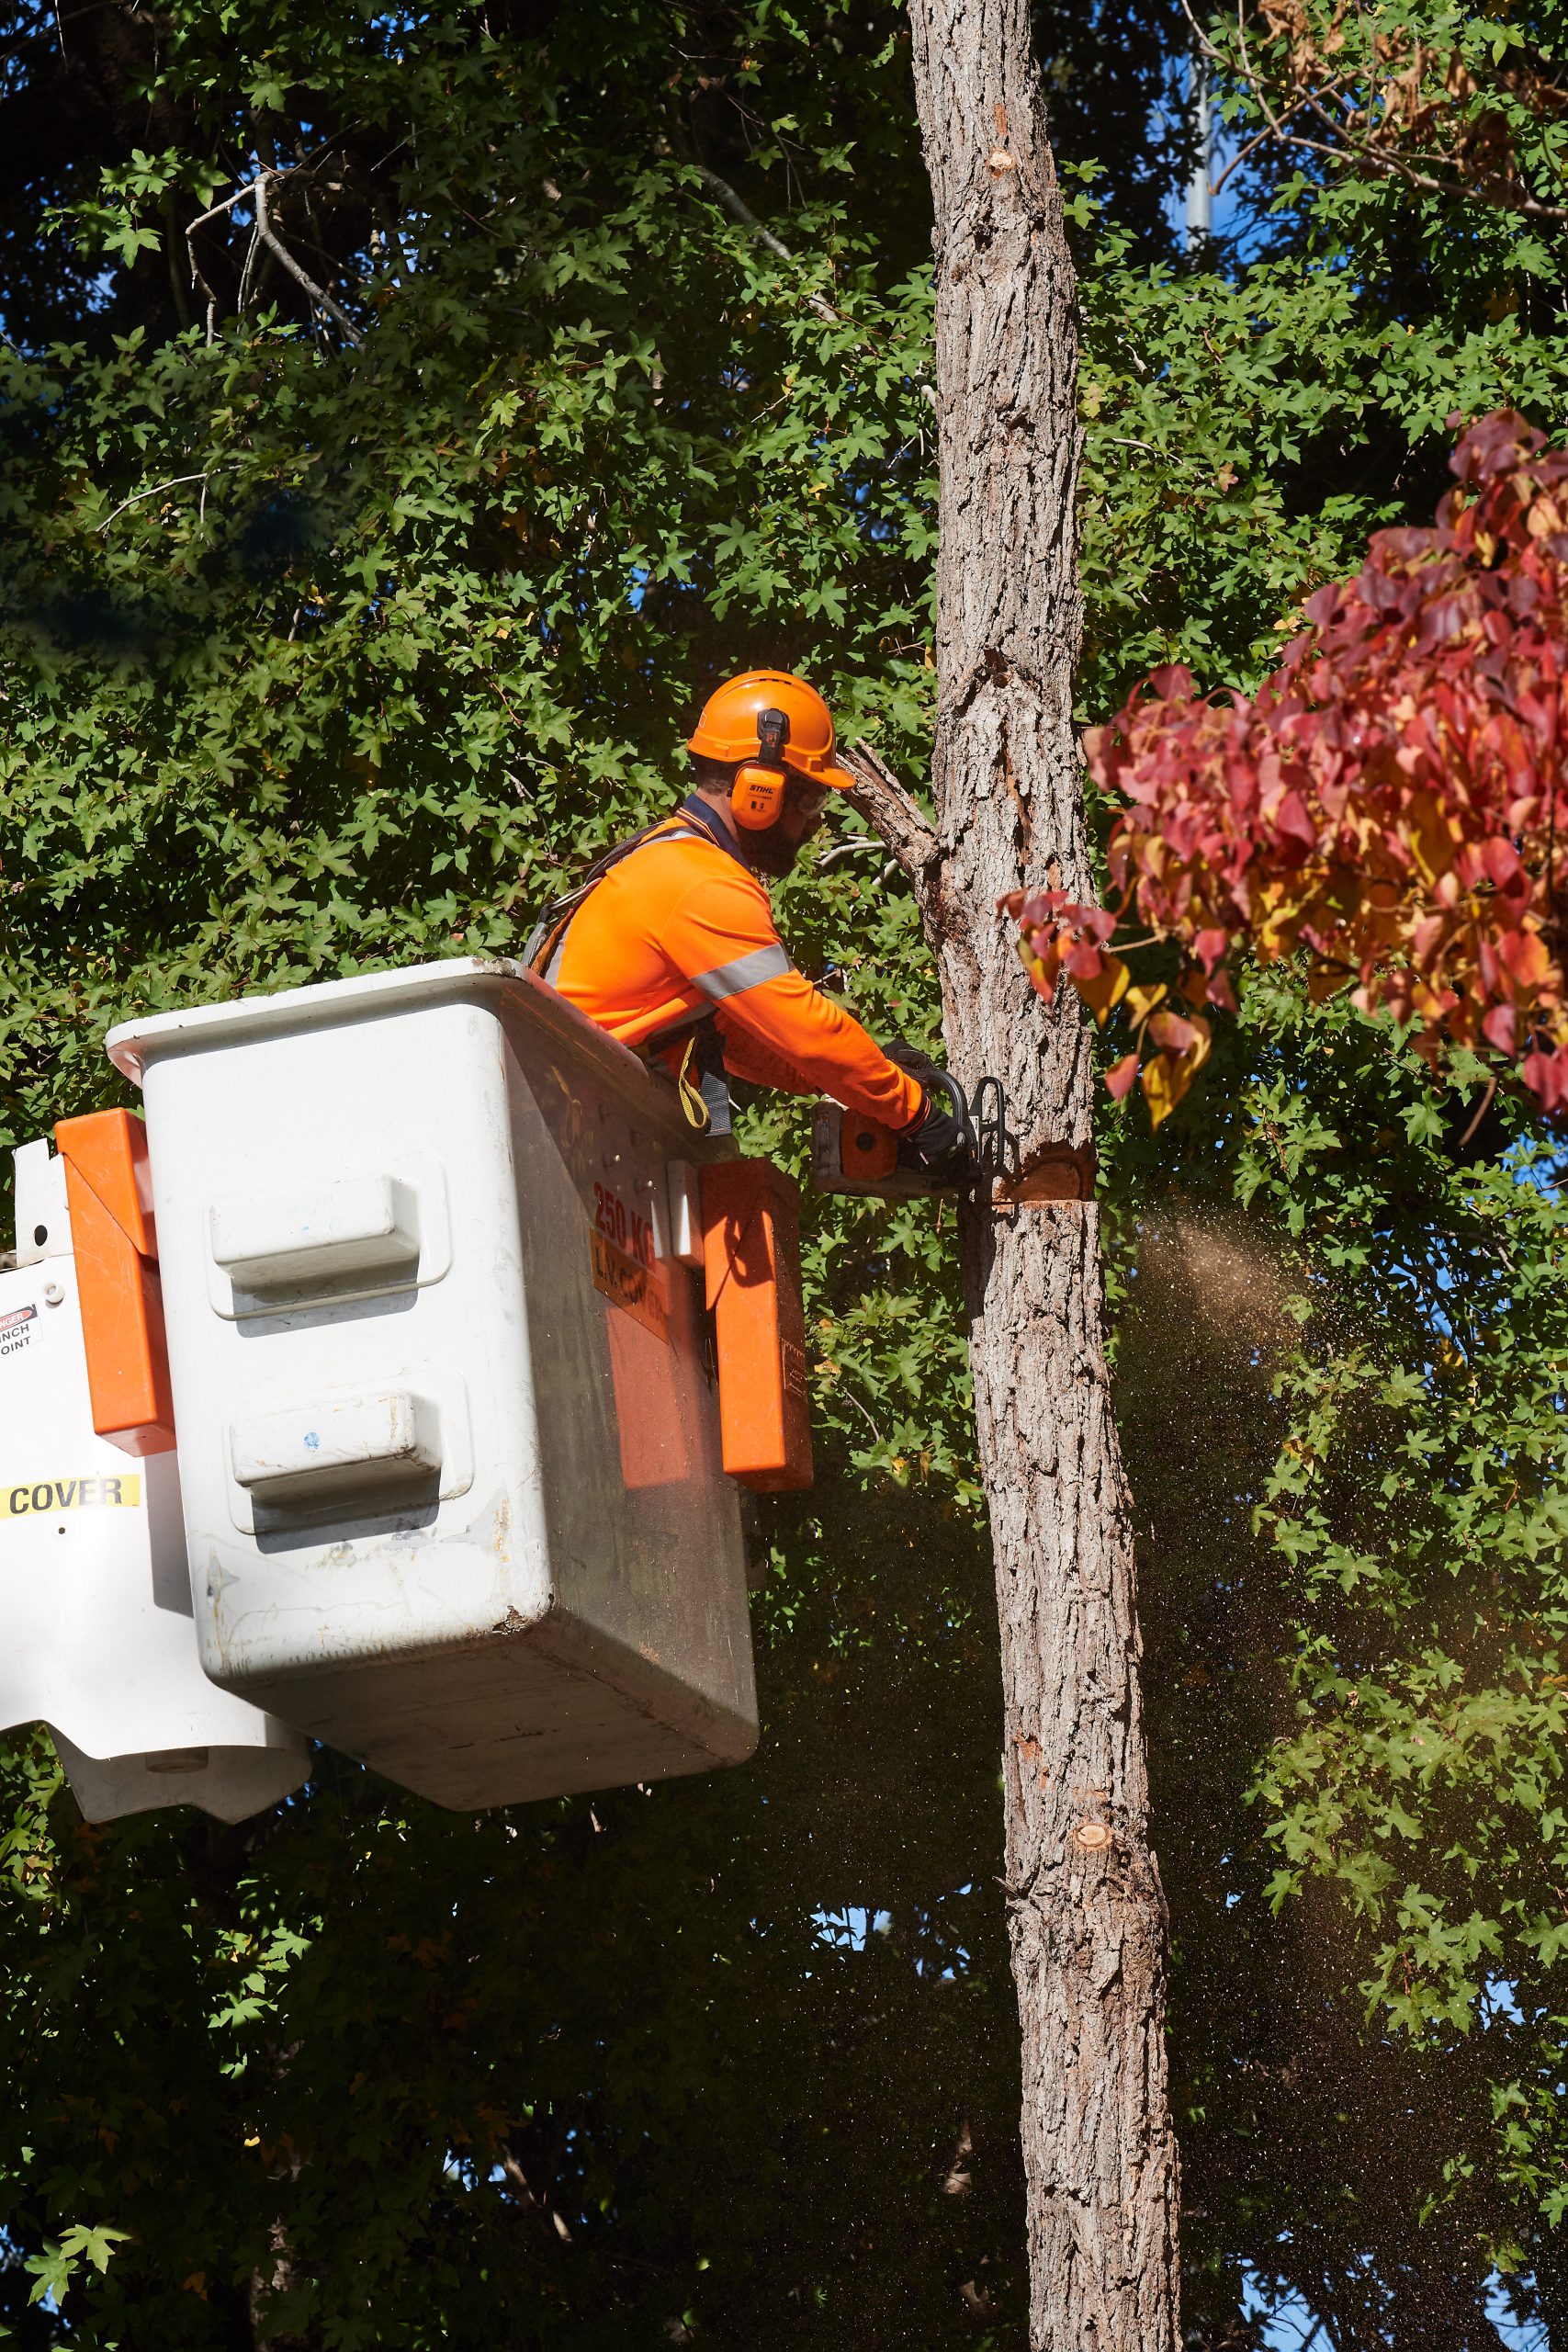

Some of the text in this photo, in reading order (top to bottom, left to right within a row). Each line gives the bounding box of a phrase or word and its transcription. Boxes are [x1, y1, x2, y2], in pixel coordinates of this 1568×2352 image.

[750, 785, 773, 794] STIHL
[594, 1182, 656, 1272] 250 KG
[10, 1478, 122, 1514] COVER
